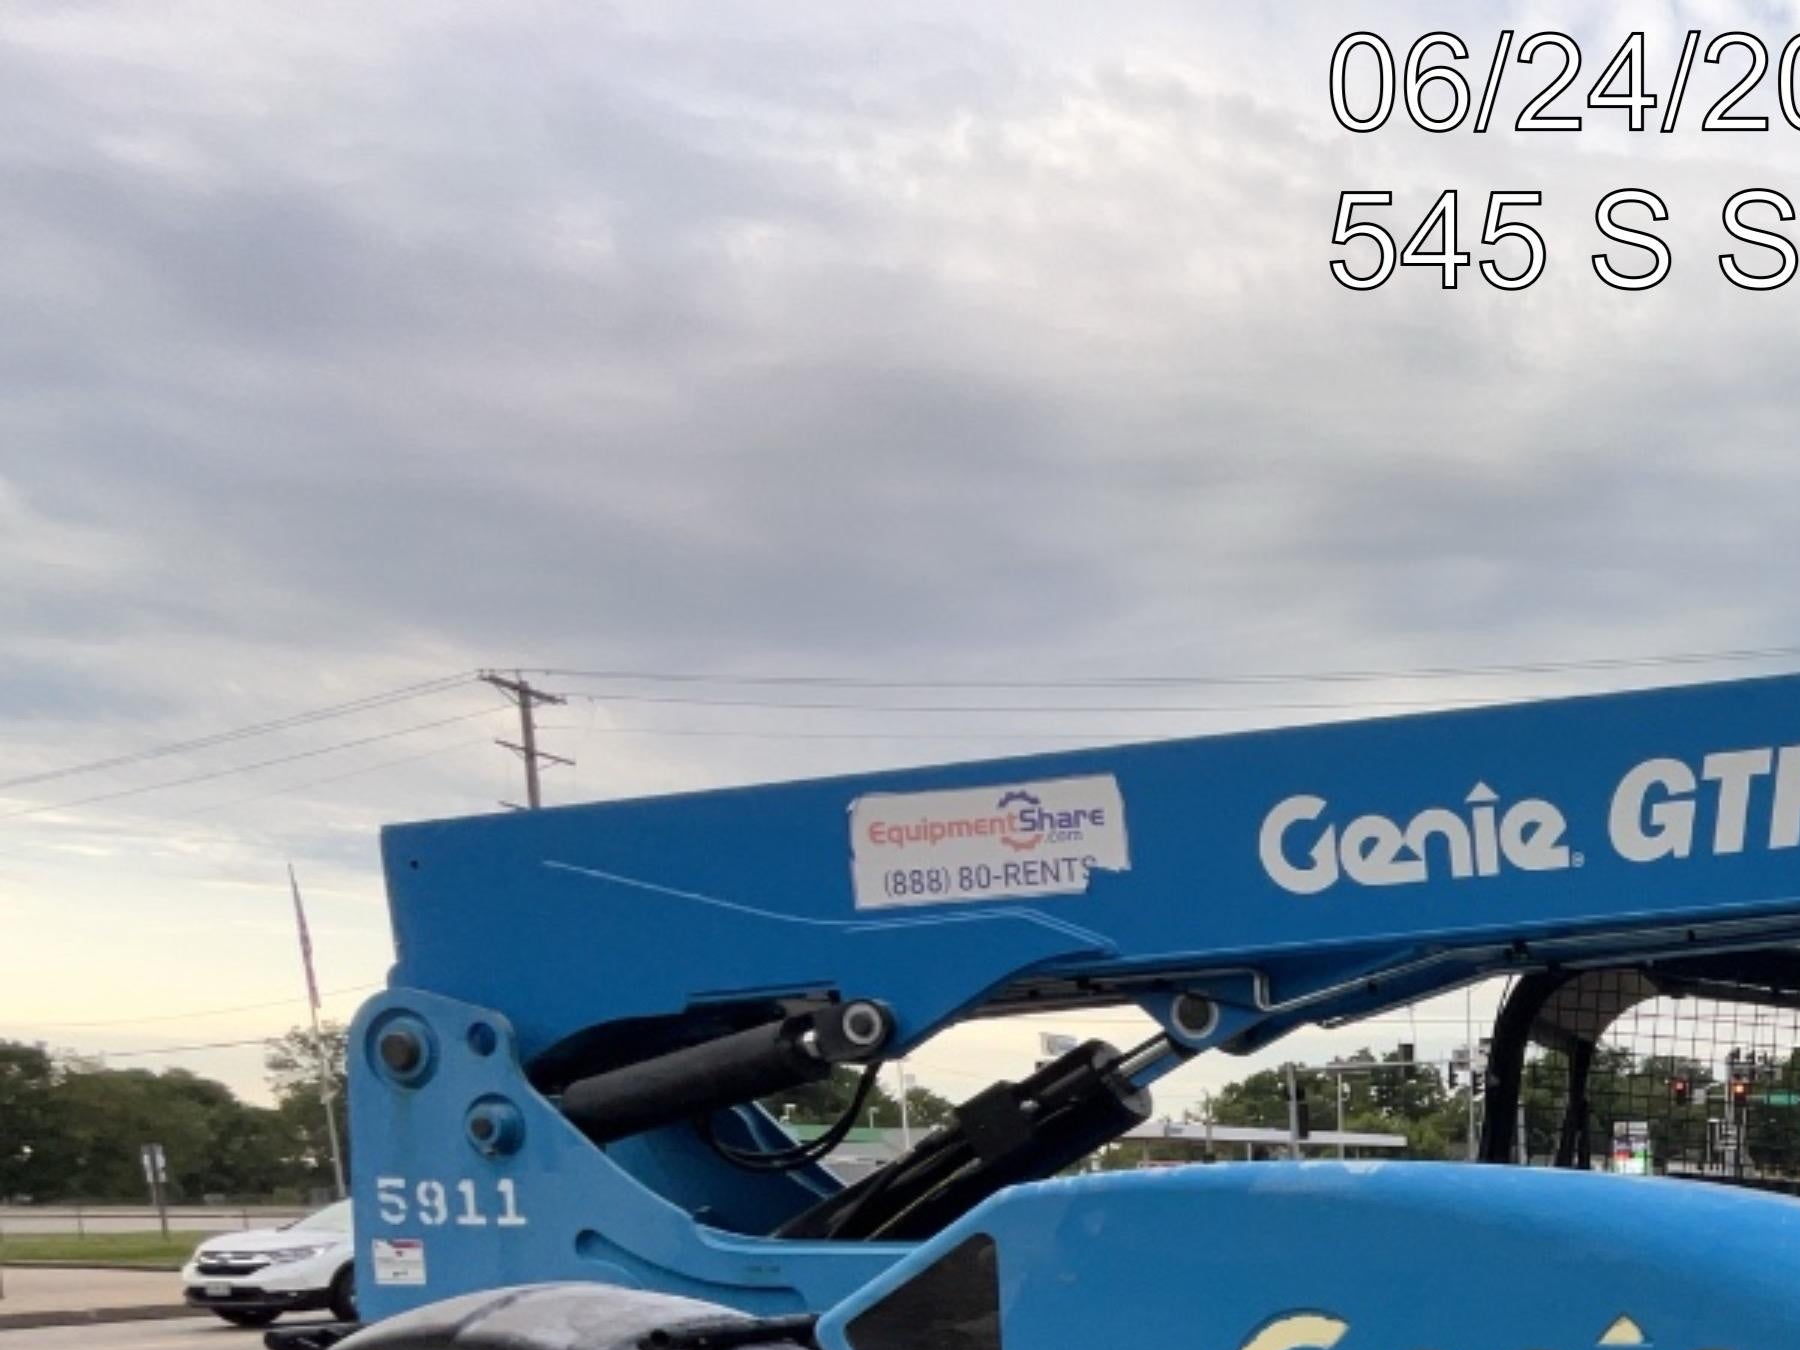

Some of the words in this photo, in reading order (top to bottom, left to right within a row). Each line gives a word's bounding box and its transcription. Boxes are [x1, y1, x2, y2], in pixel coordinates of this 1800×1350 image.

[867, 807, 1105, 846] EquipmentShare
[1259, 781, 1571, 895] Genie
[884, 866, 952, 896] (888)
[376, 1177, 528, 1226] 5911
